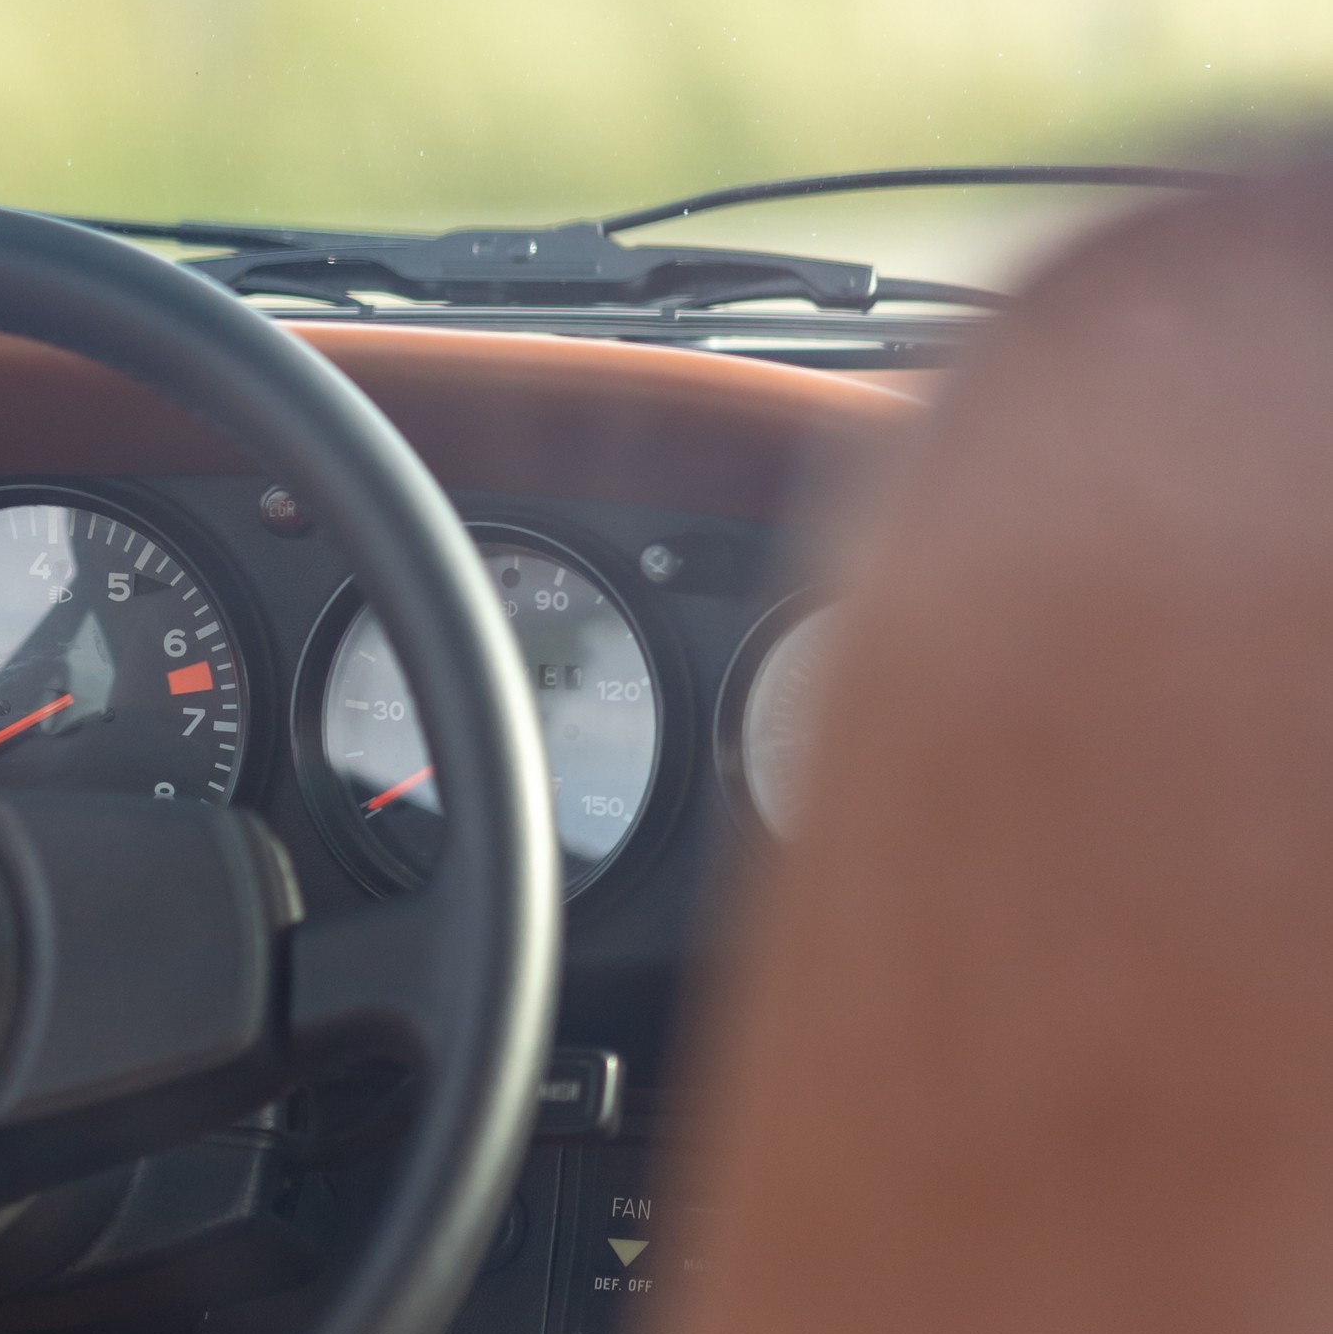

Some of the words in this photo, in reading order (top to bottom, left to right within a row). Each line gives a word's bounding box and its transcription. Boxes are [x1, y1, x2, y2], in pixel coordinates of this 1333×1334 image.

[269, 499, 296, 517] EGR
[29, 553, 52, 579] 4
[108, 573, 130, 601] 5
[534, 590, 569, 611] 90
[163, 629, 187, 657] 6
[597, 681, 640, 702] 120
[182, 707, 206, 736] 7
[373, 700, 405, 721] 30
[581, 795, 624, 817] 150
[612, 1197, 651, 1220] FAN
[594, 1277, 622, 1291] DEF.
[628, 1279, 654, 1292] OFF
